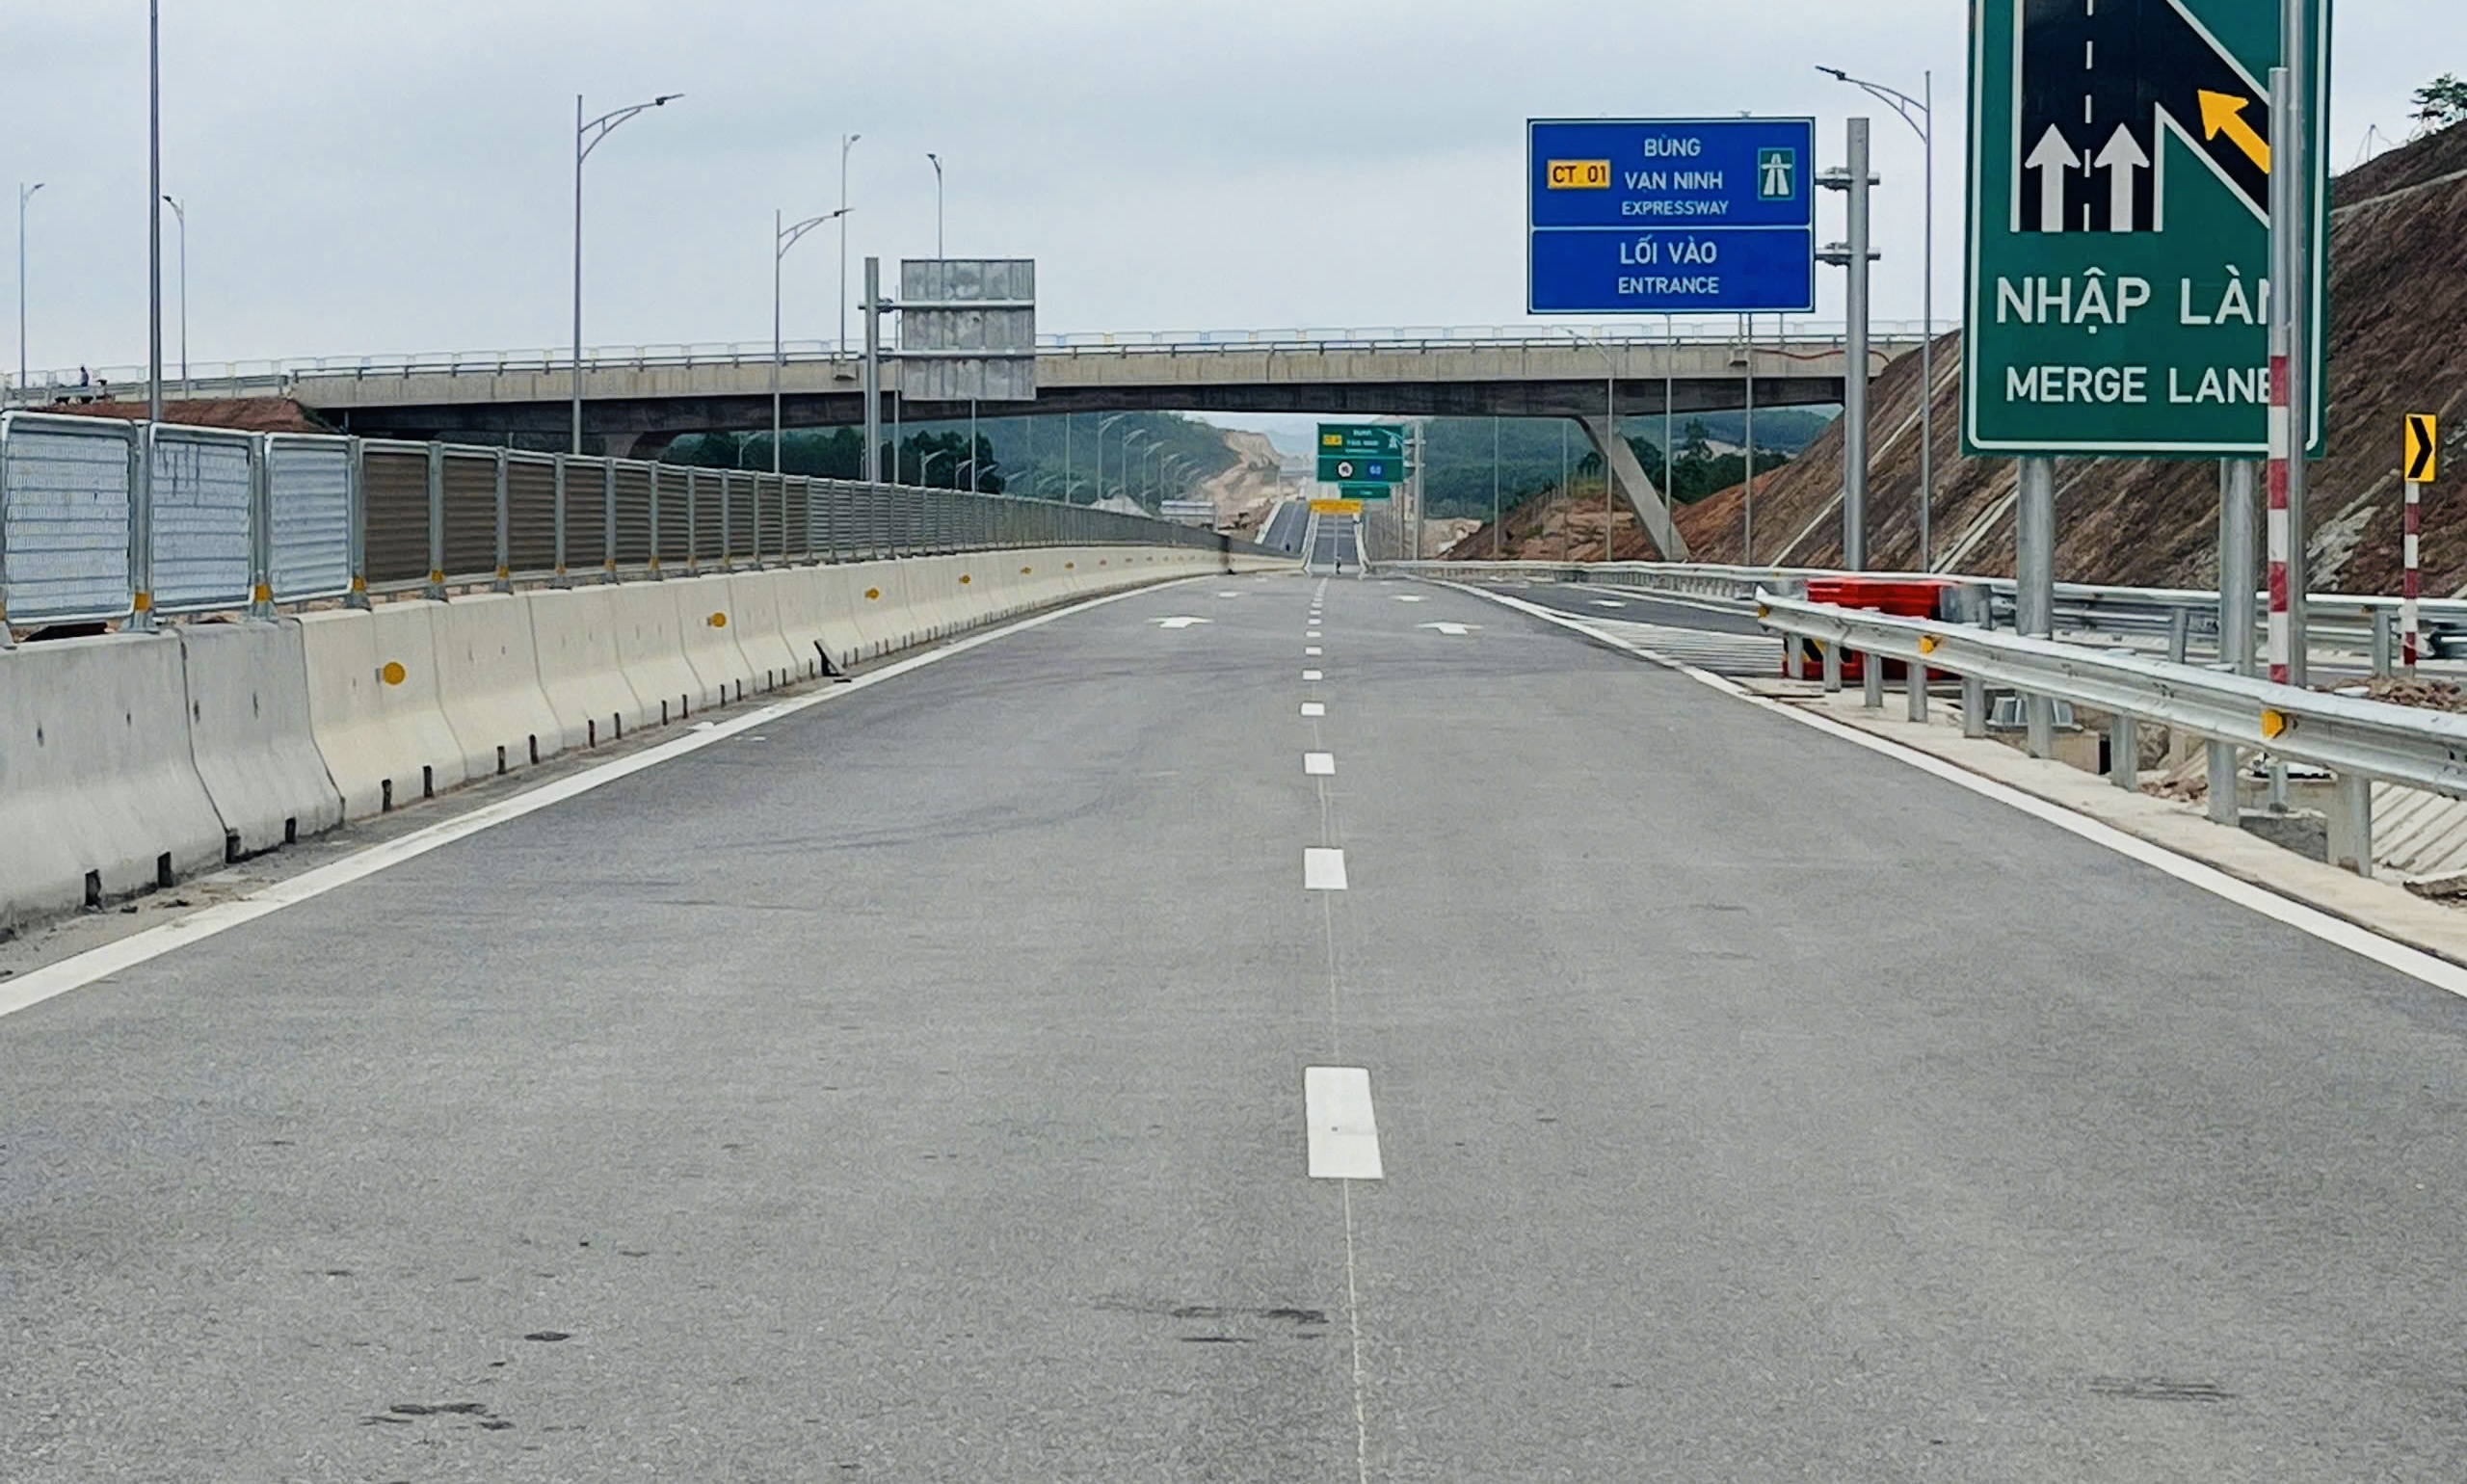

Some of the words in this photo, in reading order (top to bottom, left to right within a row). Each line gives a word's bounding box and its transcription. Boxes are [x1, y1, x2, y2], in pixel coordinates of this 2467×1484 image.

[1644, 132, 1701, 157] BÙNG
[1552, 166, 1576, 184] CT
[1587, 166, 1606, 183] 01
[1625, 171, 1667, 194] VẠN
[1674, 171, 1723, 190] NINH
[1622, 200, 1730, 216] EXPRESSWAY
[1620, 233, 1658, 264] LỐI
[1667, 235, 1717, 264] VÀO
[1618, 277, 1720, 295] ENTRANCE
[1997, 266, 2151, 334] NHẬP
[2005, 366, 2148, 403] MERGE
